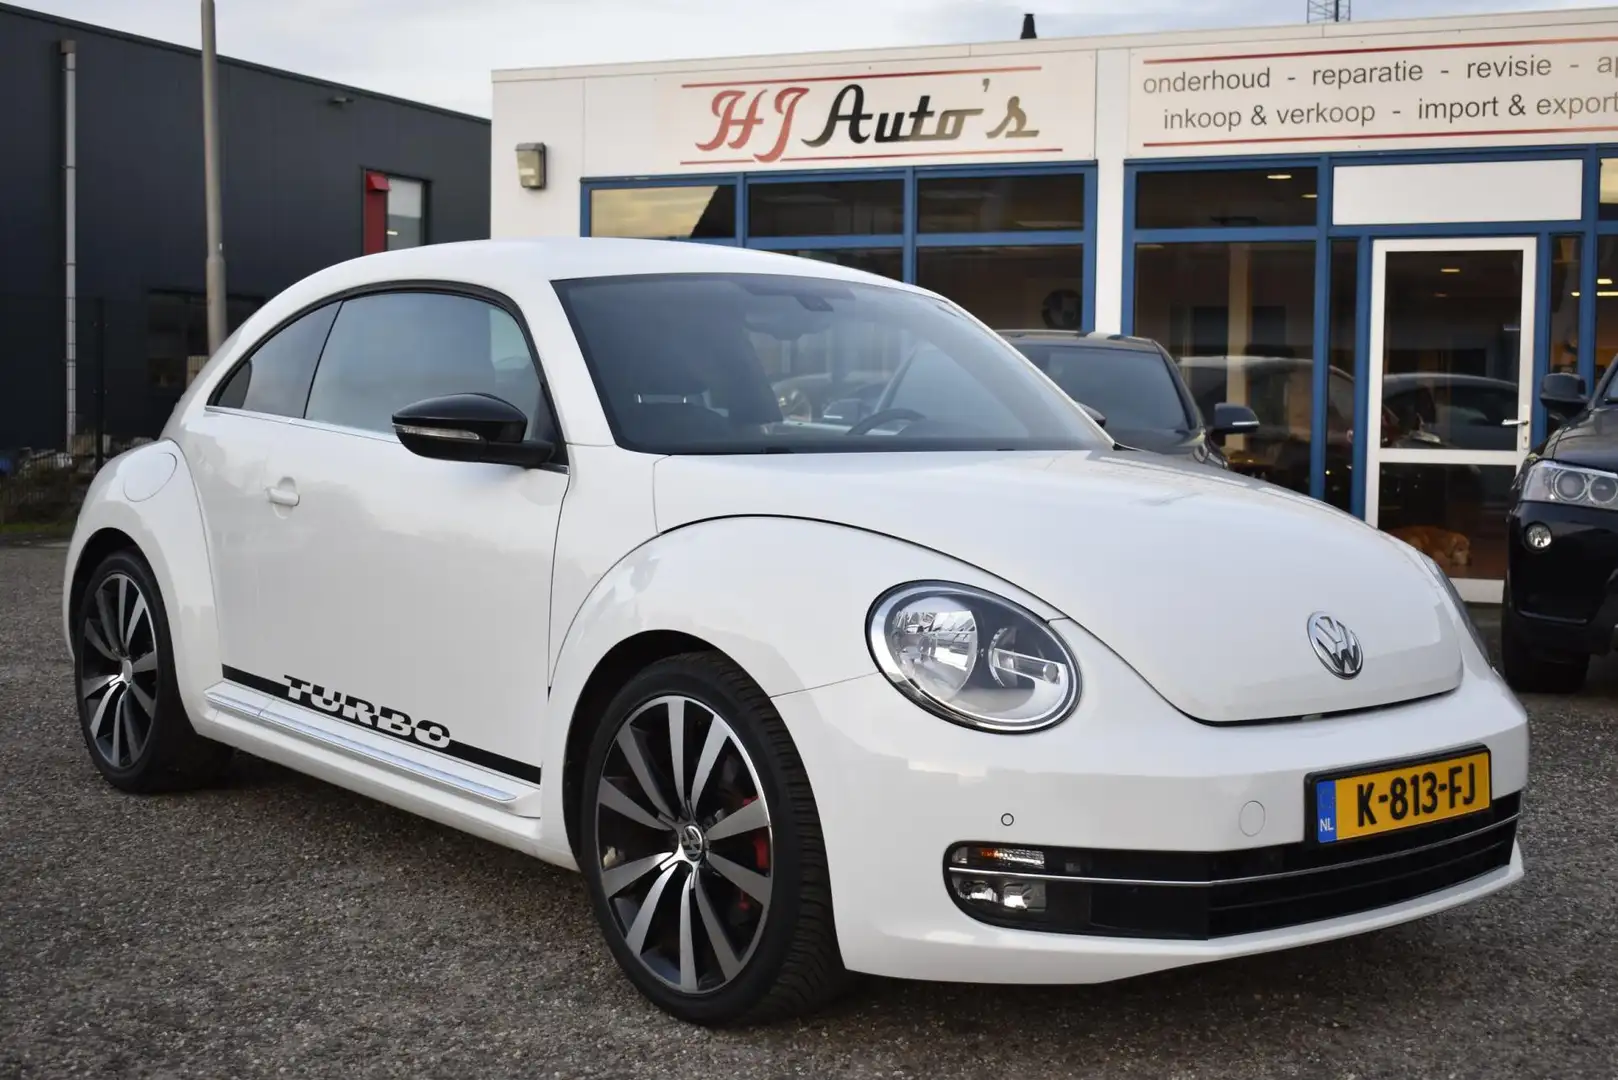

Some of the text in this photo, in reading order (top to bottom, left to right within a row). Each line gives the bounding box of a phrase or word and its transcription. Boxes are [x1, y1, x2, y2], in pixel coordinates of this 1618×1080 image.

[1143, 67, 1271, 94] onderhoud
[1312, 60, 1423, 90] reparatie
[1467, 54, 1552, 79] revisie
[695, 78, 1039, 163] HJ Auto's
[1164, 108, 1242, 132] inkoop
[1251, 104, 1268, 126] &
[1276, 102, 1376, 127] verkoop
[1418, 96, 1499, 124] import
[1508, 93, 1526, 117] &
[1536, 91, 1618, 120] export
[284, 674, 451, 749] TURBO
[1356, 762, 1476, 828] K-813-FJ
[1319, 817, 1335, 832] NL
